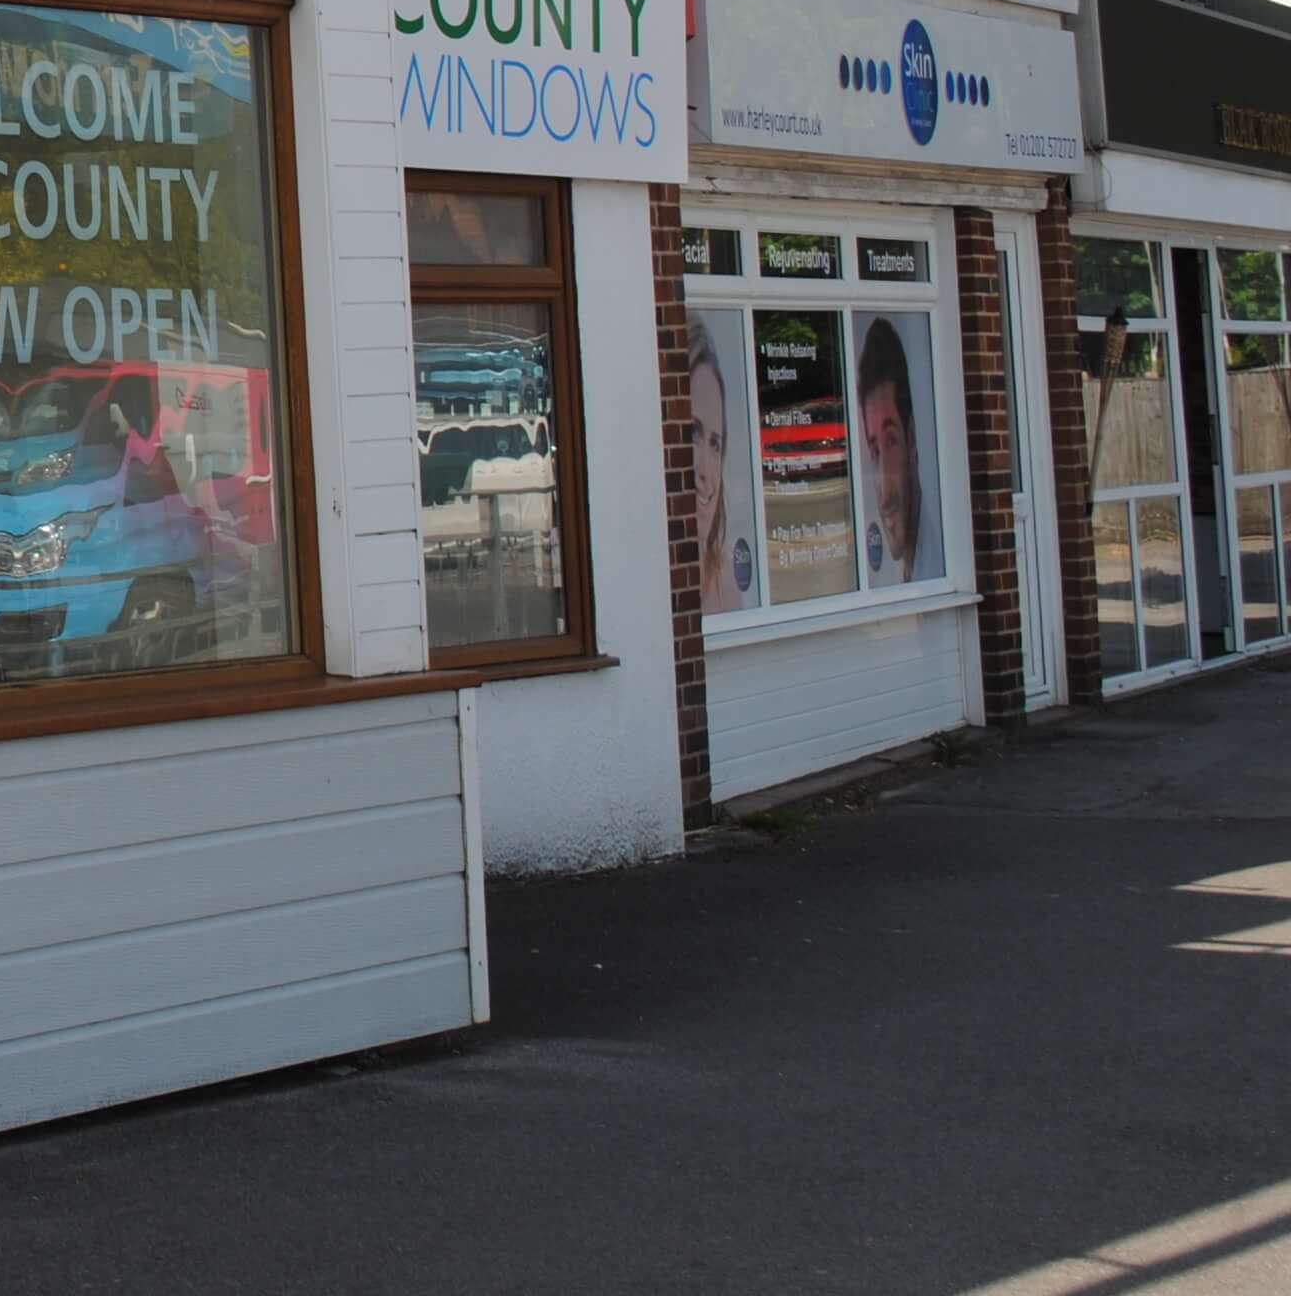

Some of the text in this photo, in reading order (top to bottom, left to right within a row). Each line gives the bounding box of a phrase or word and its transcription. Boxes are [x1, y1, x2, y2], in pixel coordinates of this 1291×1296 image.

[903, 42, 933, 80] Skin
[721, 105, 822, 136] www.harleycourt.co.uk
[1005, 134, 1017, 156] Tel
[1020, 134, 1046, 158] 01202
[682, 239, 915, 274] acial Rejuvenating Treatments
[61, 286, 219, 364] OPEN
